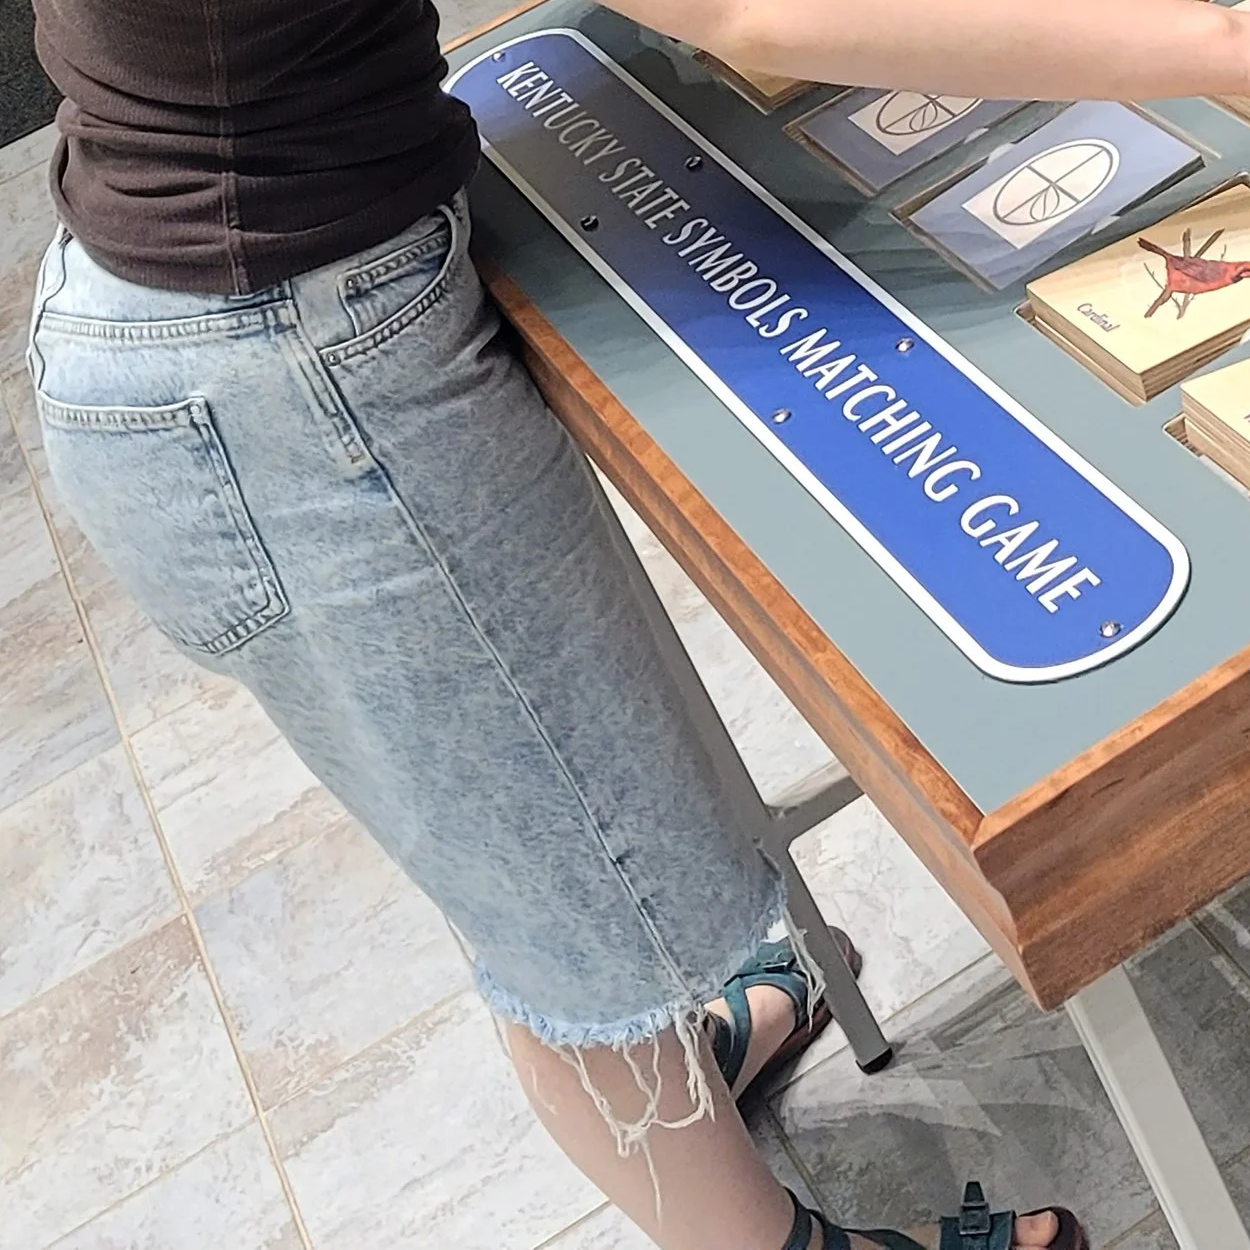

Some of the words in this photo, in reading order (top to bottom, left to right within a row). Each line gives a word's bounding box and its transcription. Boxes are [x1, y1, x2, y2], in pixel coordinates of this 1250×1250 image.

[496, 61, 627, 166] KENTUCKY
[598, 157, 691, 230] STATE
[662, 217, 809, 339] SYMBOLS
[779, 327, 982, 503] MATCHING
[959, 494, 1102, 614] GAME
[1076, 303, 1121, 333] Cardinal
